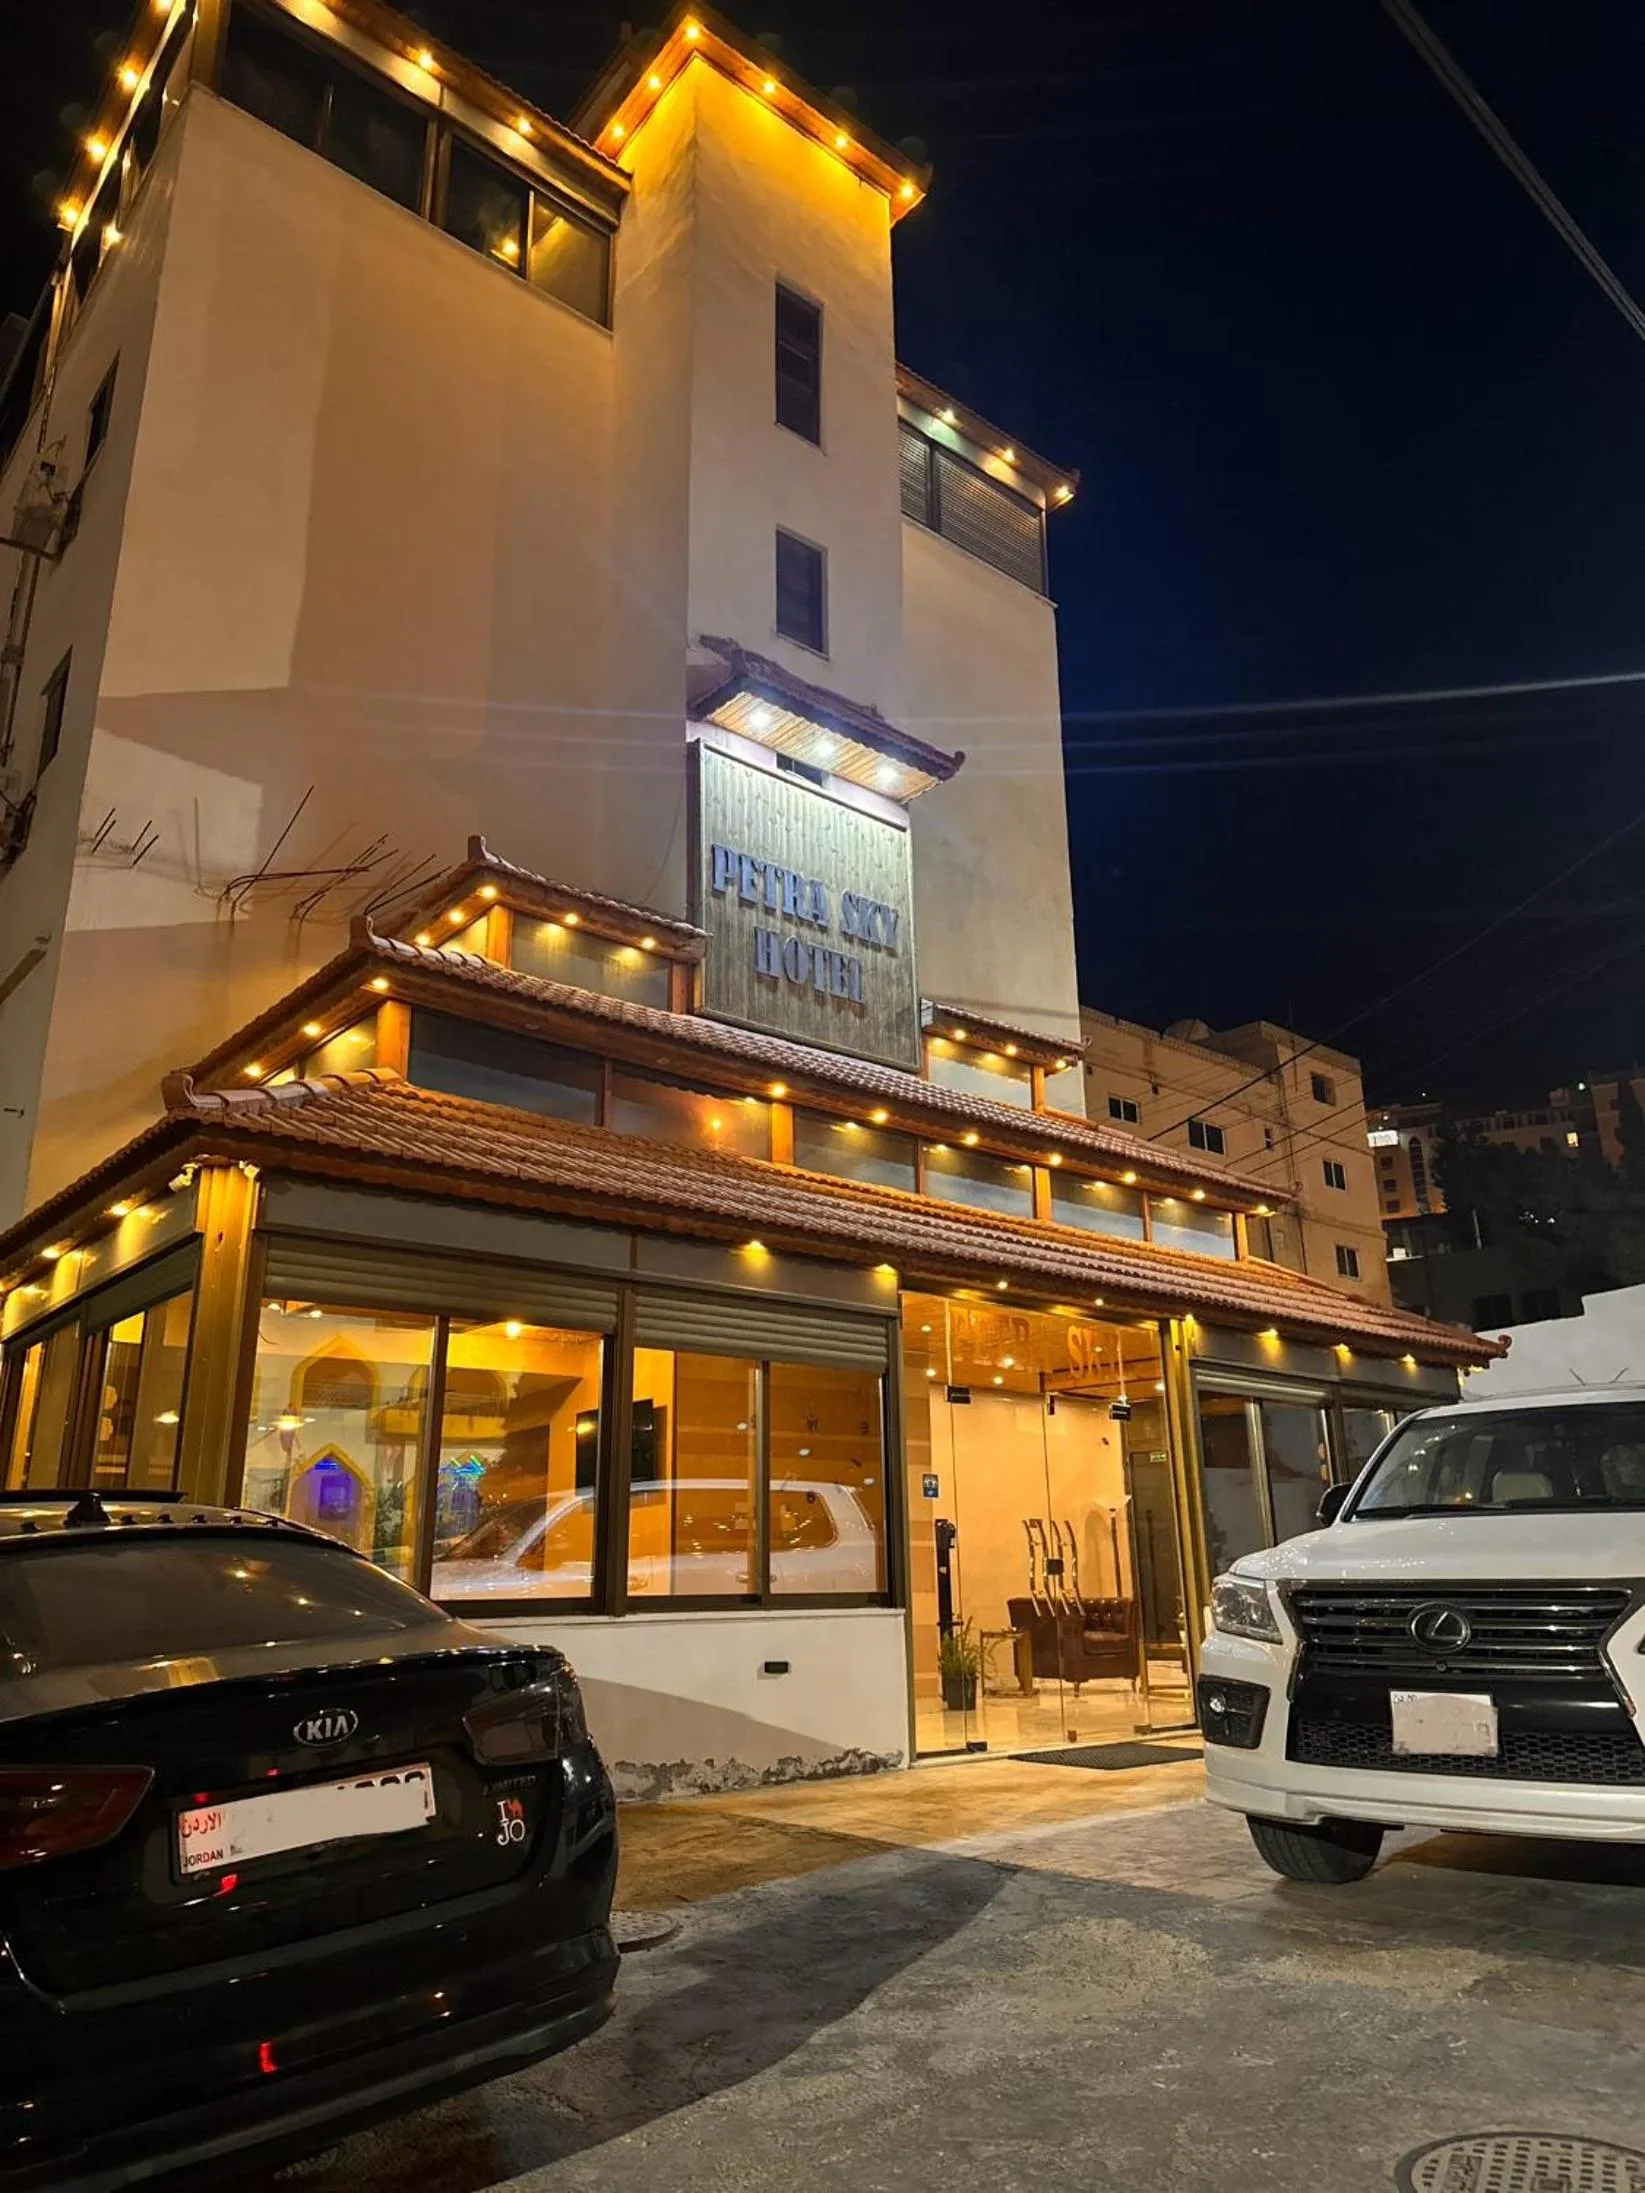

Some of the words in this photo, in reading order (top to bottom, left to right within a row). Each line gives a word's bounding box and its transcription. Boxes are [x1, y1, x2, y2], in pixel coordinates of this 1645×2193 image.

[712, 843, 829, 927] PETRA
[841, 888, 899, 951] SKY
[754, 926, 866, 1004] HOTEL
[307, 1715, 348, 1741] KIA
[496, 1818, 526, 1846] JO
[183, 1848, 224, 1868] JORDAN
